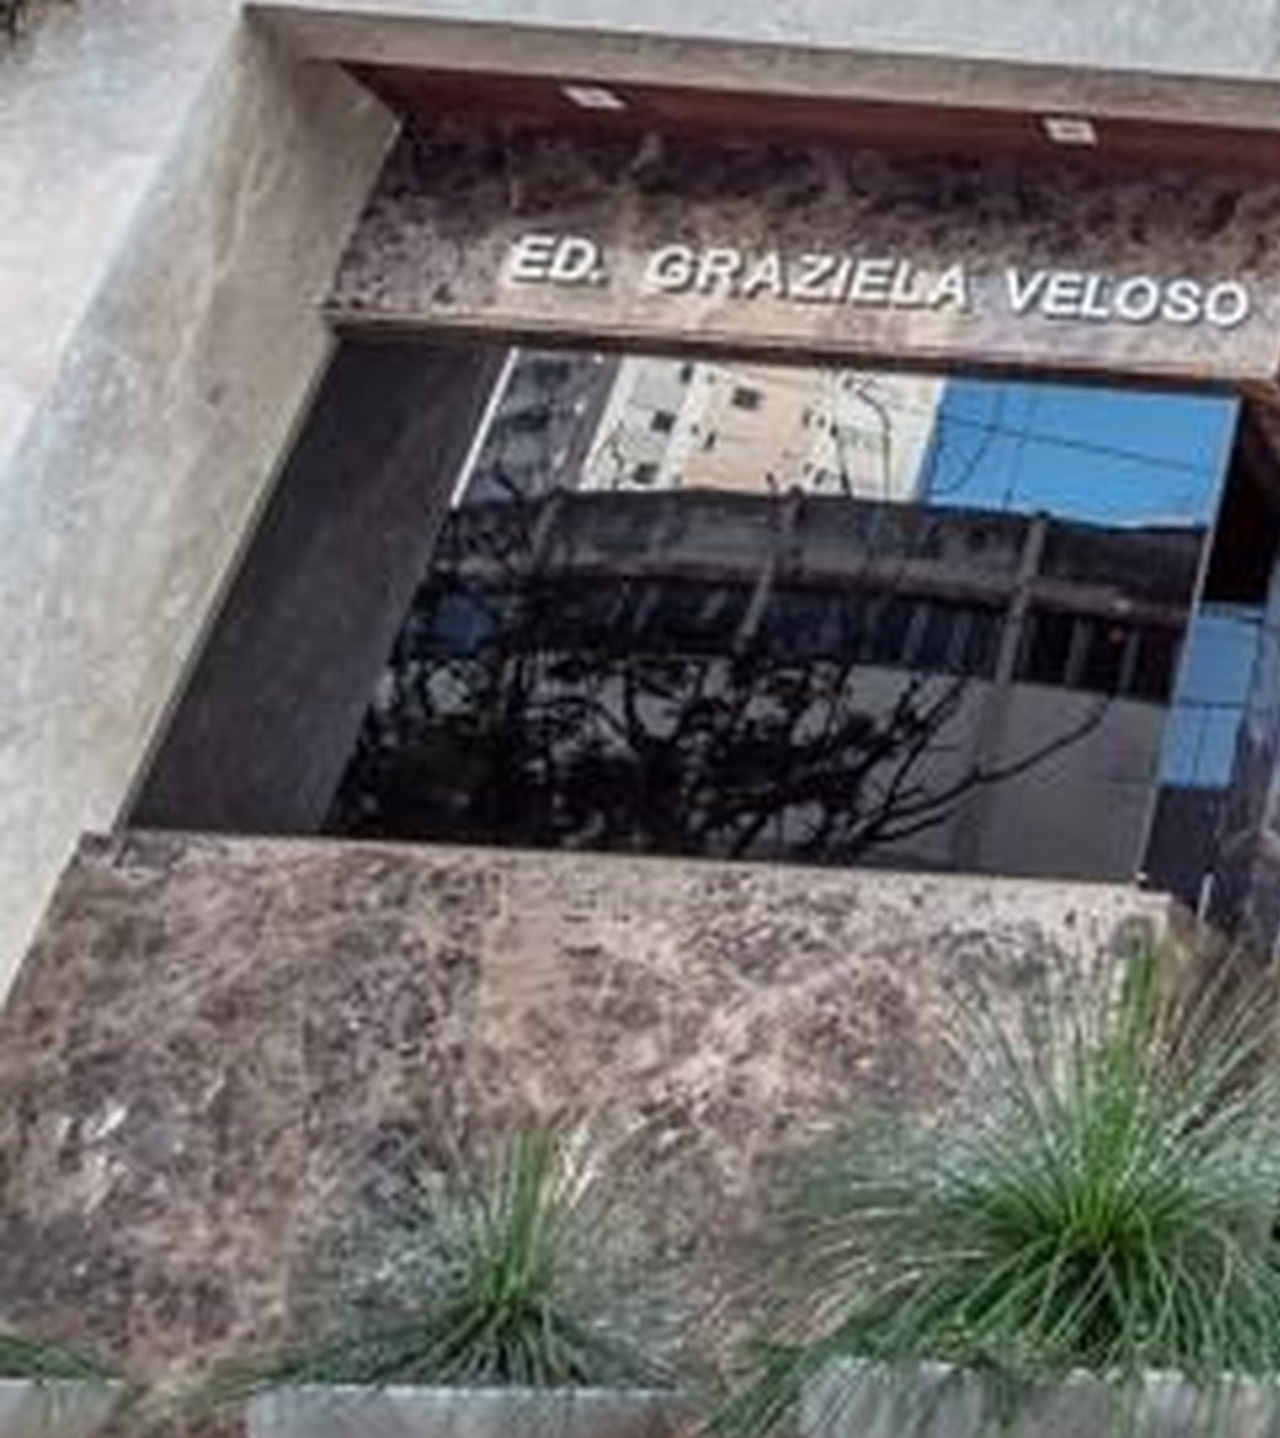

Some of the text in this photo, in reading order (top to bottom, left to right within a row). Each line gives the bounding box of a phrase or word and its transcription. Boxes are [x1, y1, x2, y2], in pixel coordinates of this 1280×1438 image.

[510, 233, 1251, 326] ED. GRAZIELA VELOSO
